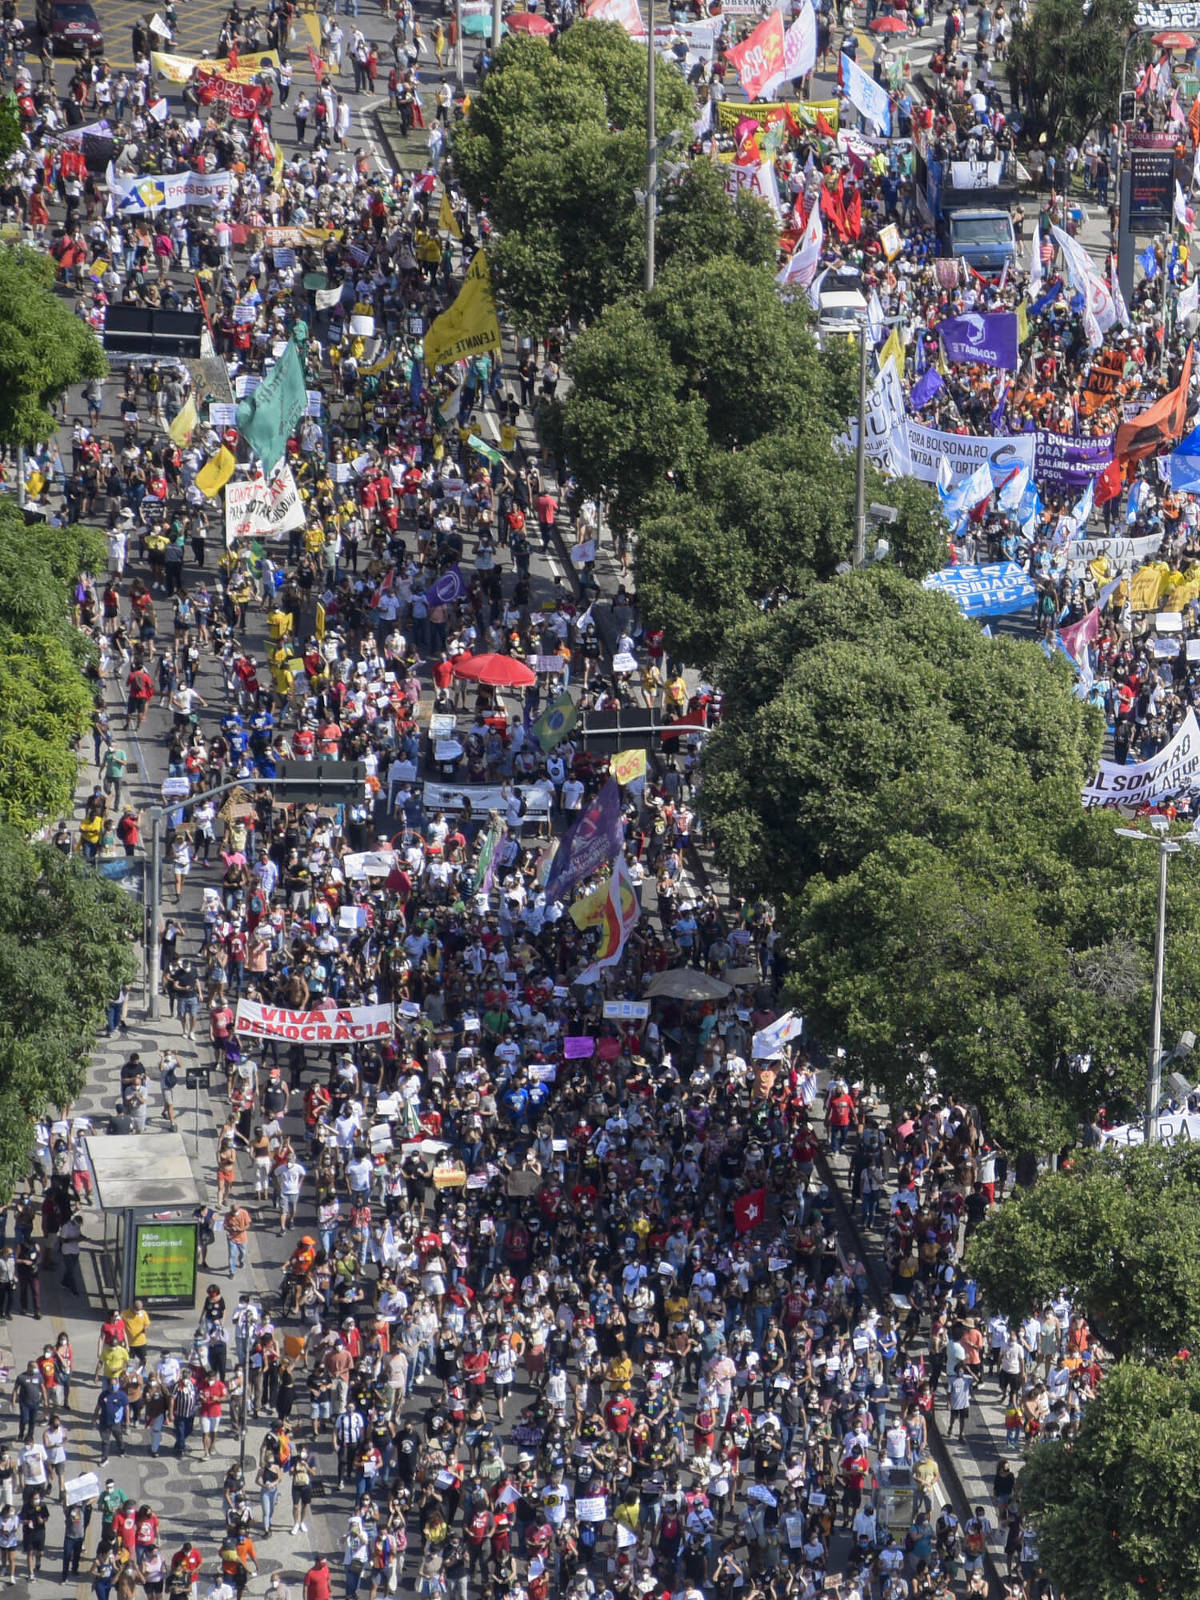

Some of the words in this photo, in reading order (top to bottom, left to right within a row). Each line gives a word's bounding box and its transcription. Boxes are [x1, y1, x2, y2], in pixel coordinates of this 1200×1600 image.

[168, 184, 230, 196] PRESENTE
[908, 429, 926, 447] FORA
[926, 436, 989, 459] BOLSONARO
[1048, 433, 1111, 449] BOLSONARO
[1076, 542, 1096, 557] NA
[261, 1006, 327, 1025] VIVA
[335, 1010, 354, 1024] A
[237, 1016, 391, 1041] DEMOCRACIA
[1126, 1118, 1191, 1146] FRA
